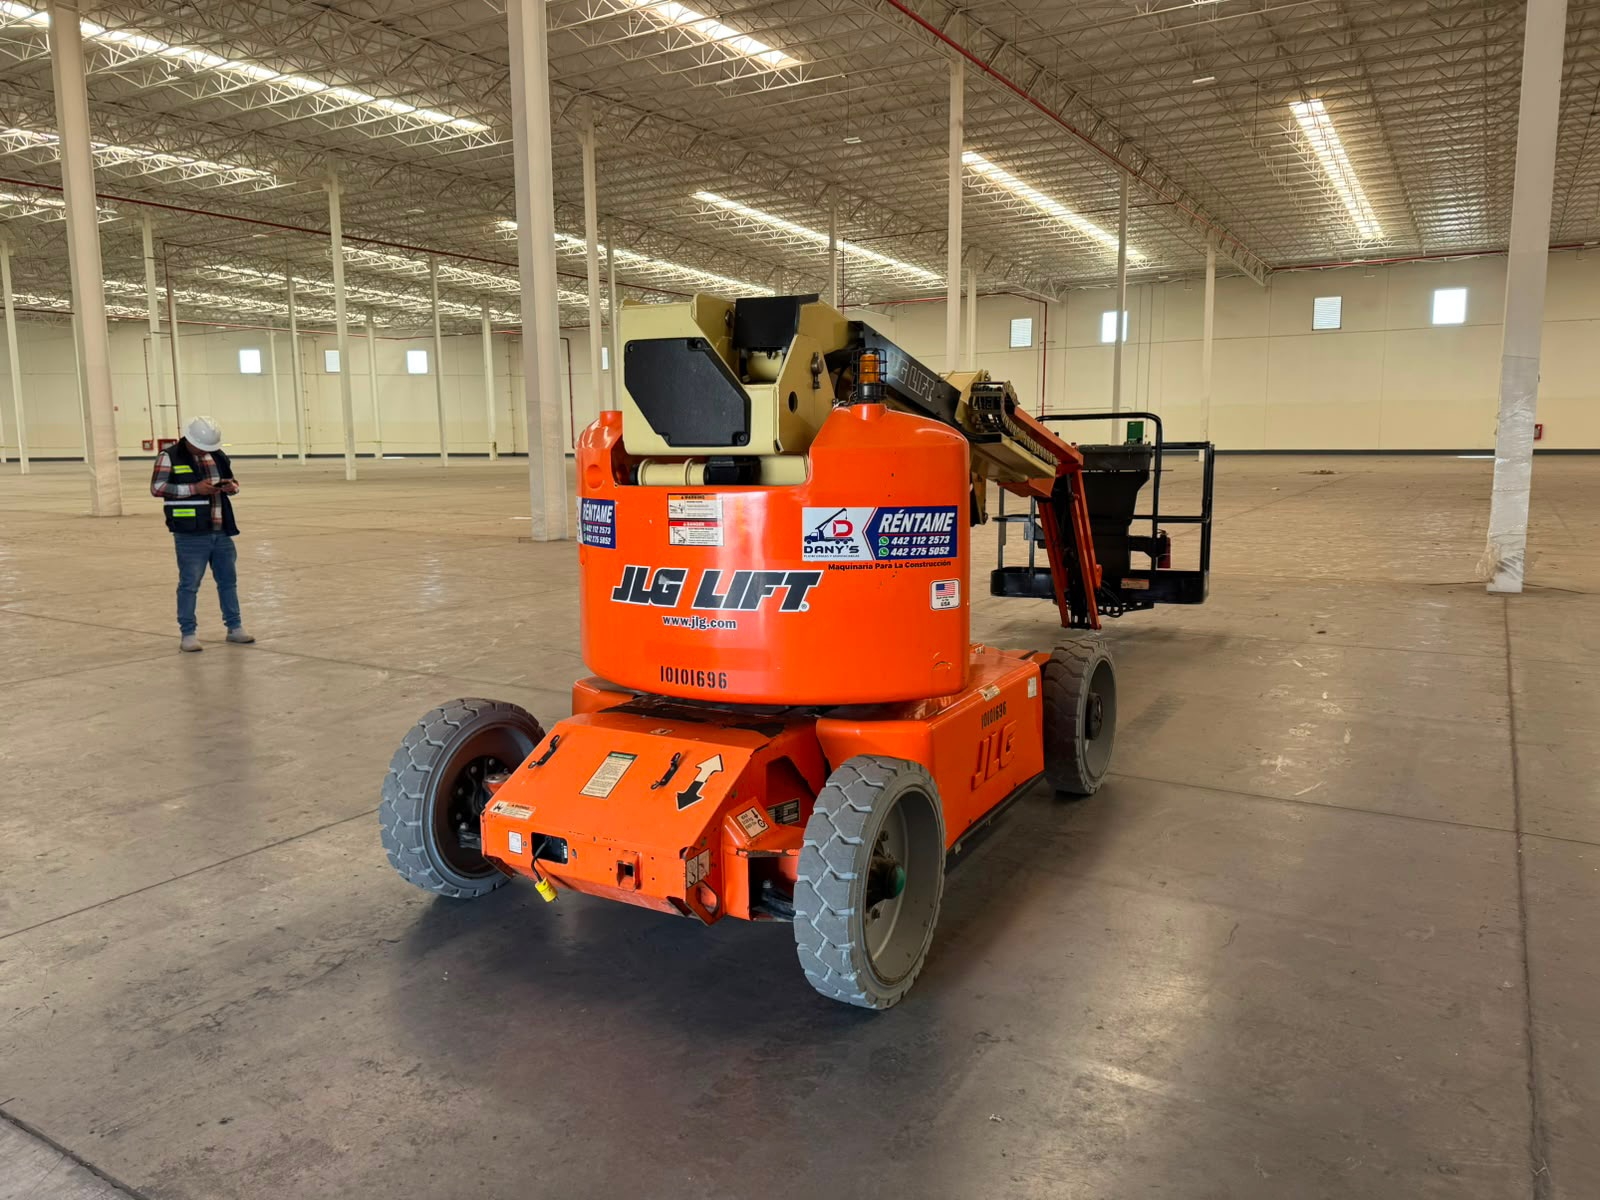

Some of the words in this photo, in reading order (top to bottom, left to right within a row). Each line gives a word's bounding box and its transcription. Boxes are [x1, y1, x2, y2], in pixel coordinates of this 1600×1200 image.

[908, 366, 936, 402] LIFT
[583, 500, 613, 523] RÉNTAME
[879, 509, 955, 533] RÉNTAME
[804, 545, 859, 554] DANY'S
[891, 537, 909, 545] 442
[911, 536, 926, 545] 112
[928, 535, 950, 544] 2573
[890, 548, 910, 556] 442
[910, 547, 927, 556] 275
[928, 546, 950, 555] 5052
[828, 563, 873, 572] Maquinaria
[875, 562, 893, 570] Para
[905, 560, 951, 569] Construcción
[611, 564, 689, 608] JLG
[691, 568, 824, 612] LIFT
[661, 615, 737, 630] www.jlg.com
[660, 665, 727, 689] 10101696
